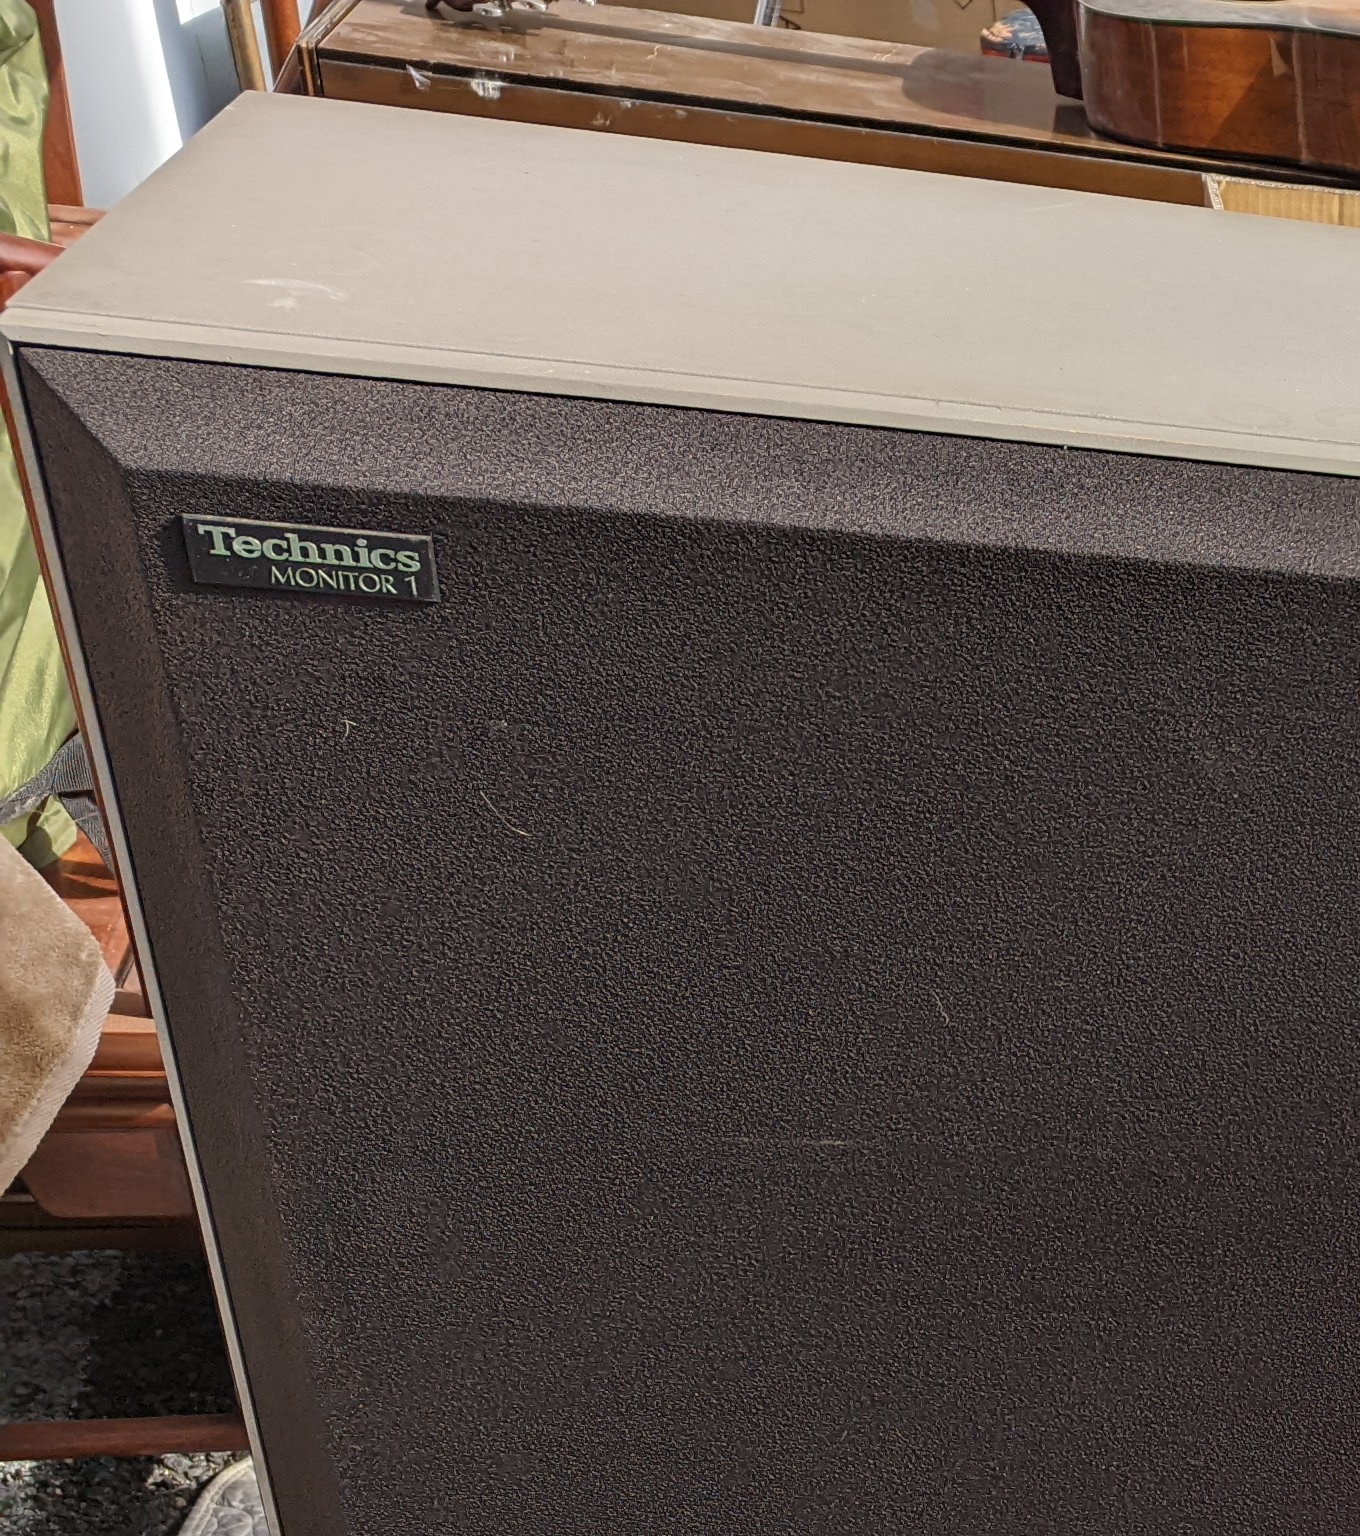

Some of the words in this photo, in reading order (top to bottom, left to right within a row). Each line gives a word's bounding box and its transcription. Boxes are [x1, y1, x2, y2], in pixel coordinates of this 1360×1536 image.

[197, 523, 421, 572] Technics
[271, 566, 398, 595] MONITOR
[404, 575, 418, 597] 1
